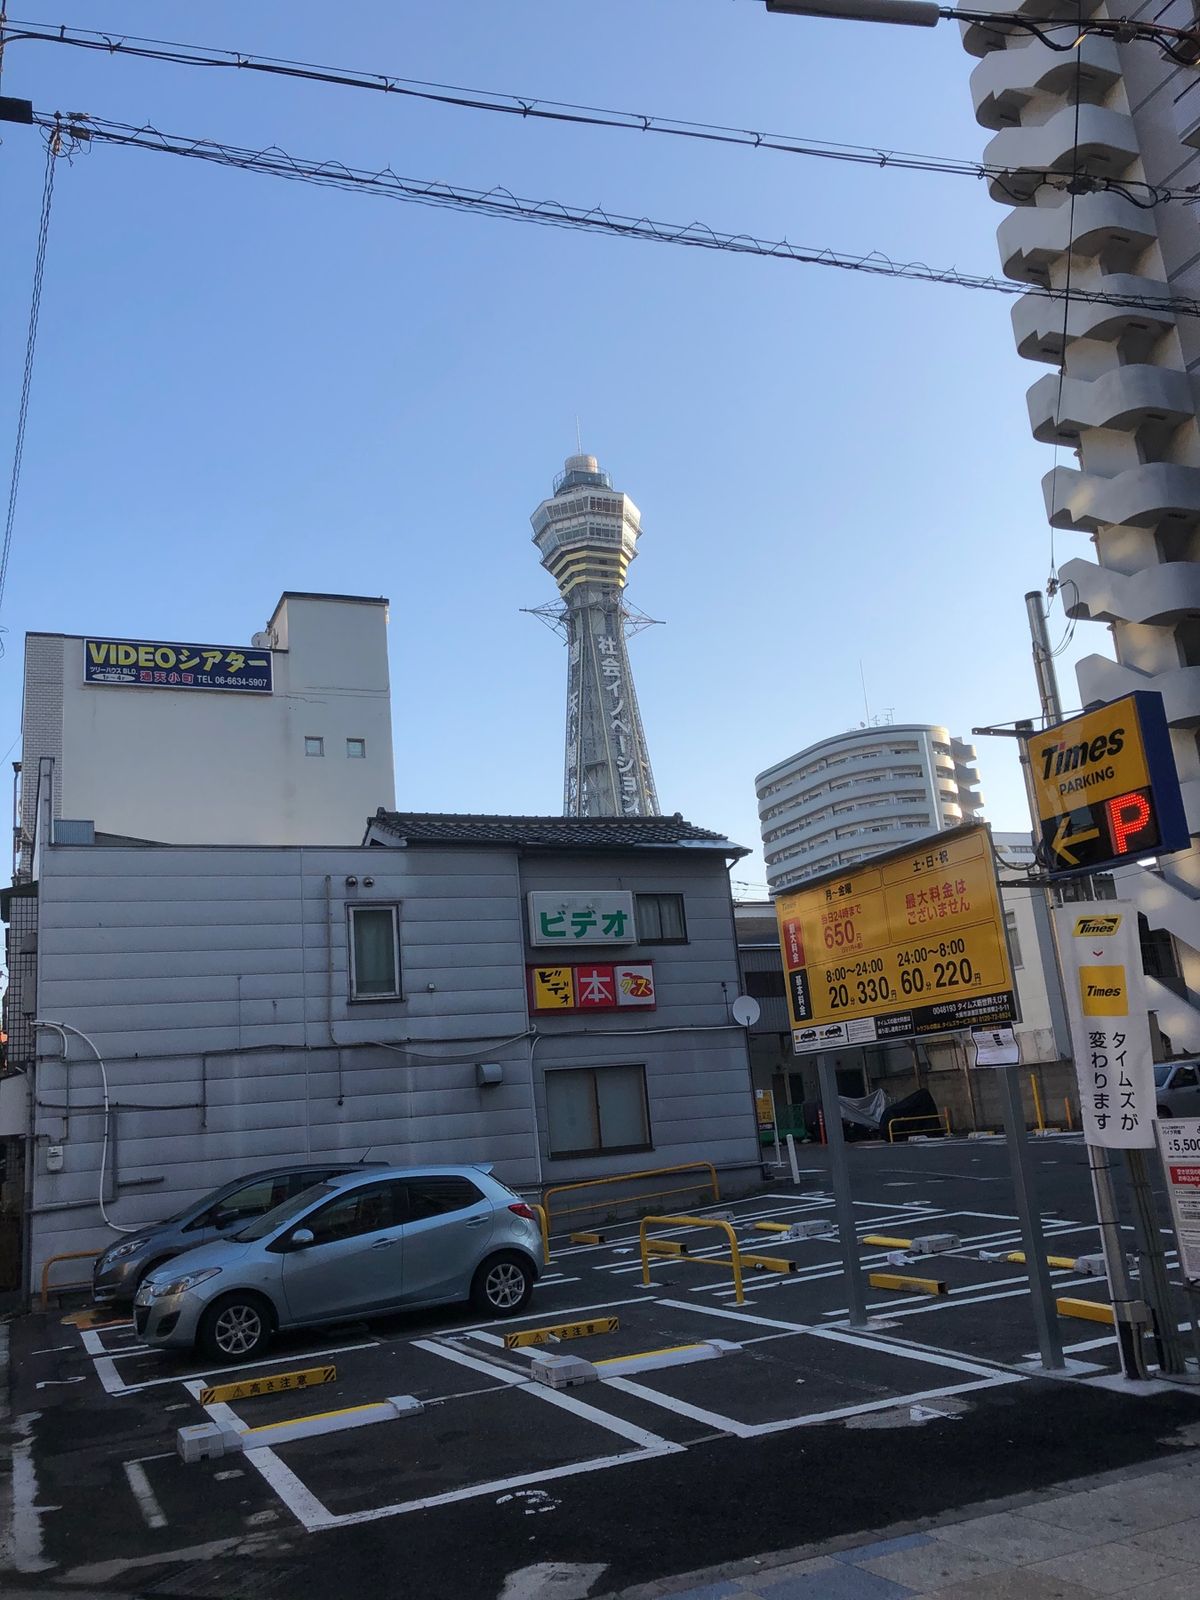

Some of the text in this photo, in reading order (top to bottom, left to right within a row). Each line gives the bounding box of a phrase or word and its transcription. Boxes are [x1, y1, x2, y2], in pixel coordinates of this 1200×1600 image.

[89, 643, 268, 673] VIDEOシアター
[140, 671, 194, 684] 通天小町
[197, 675, 268, 687] TEL 06-6634-5907
[599, 636, 639, 813] 社会イノベーション
[1041, 728, 1125, 780] Times
[1059, 766, 1115, 795] PARKING
[1108, 792, 1150, 855] P
[905, 879, 967, 910] 最大料金は
[540, 910, 628, 939] ビデオ
[907, 897, 971, 926] ございません
[1079, 919, 1117, 934] Times
[538, 970, 570, 1005] ビデオ
[580, 970, 613, 1003] 本
[1087, 985, 1121, 997] Times
[1089, 1031, 1111, 1130] 変わります
[1112, 1031, 1139, 1131] タイムズが
[250, 1374, 307, 1393] 高さ注意
